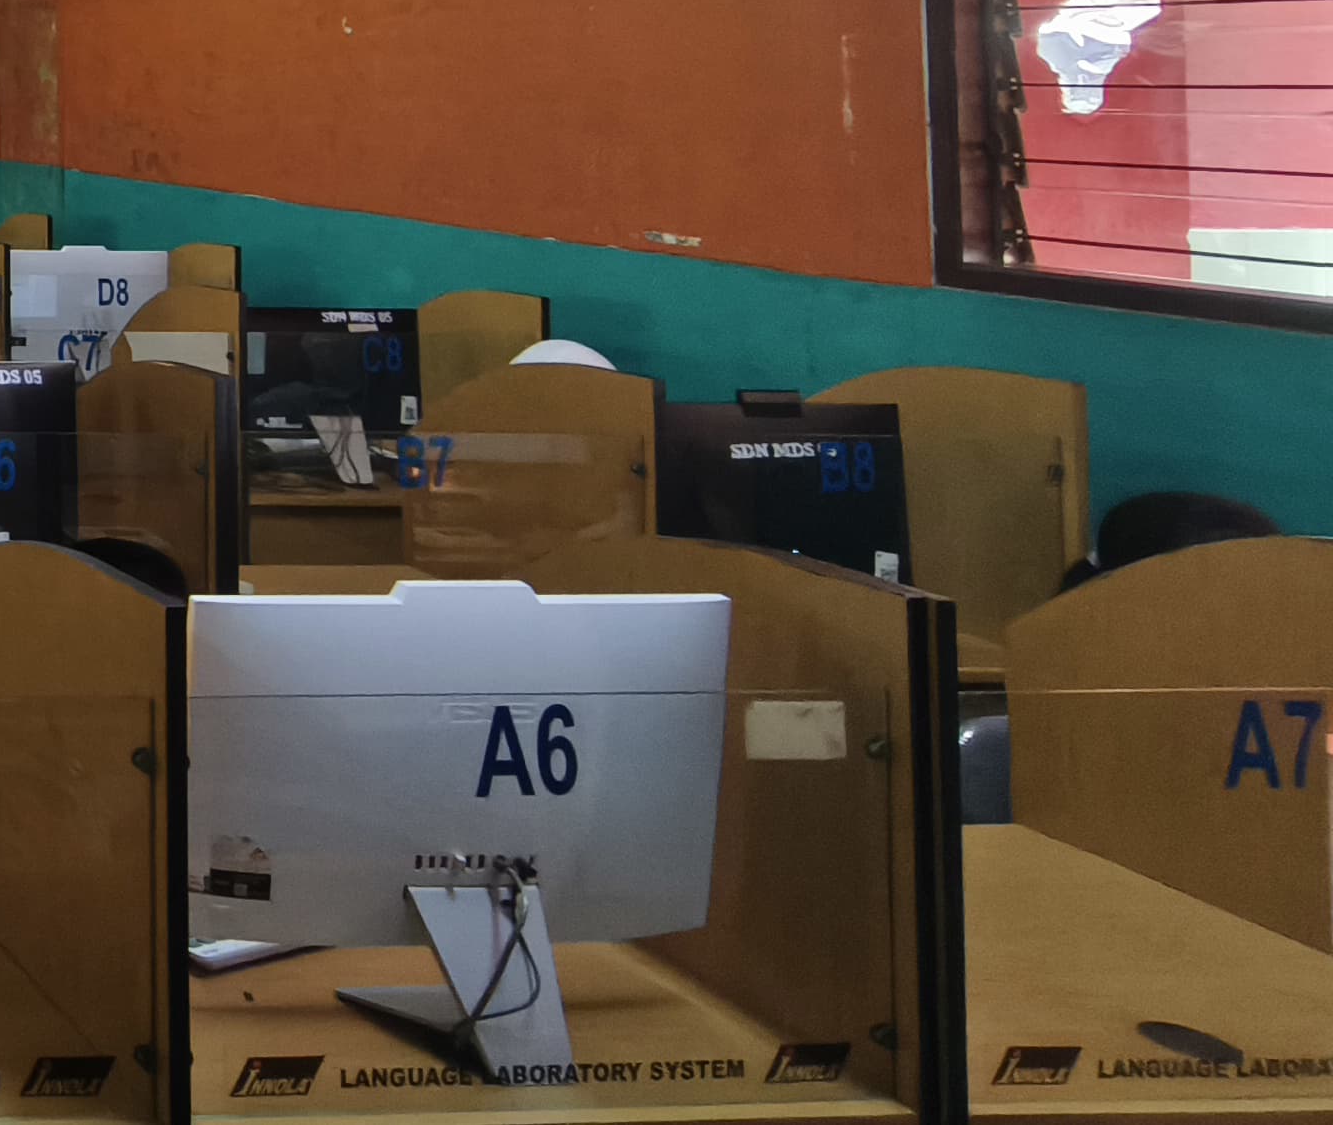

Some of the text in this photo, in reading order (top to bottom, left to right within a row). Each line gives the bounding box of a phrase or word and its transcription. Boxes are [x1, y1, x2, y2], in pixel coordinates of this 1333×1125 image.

[98, 278, 129, 306] D8
[58, 334, 102, 372] C7
[363, 335, 405, 374] C8
[23, 369, 44, 385] 05
[396, 436, 453, 489] B7
[729, 442, 769, 459] SDN
[771, 442, 816, 458] MDS
[819, 442, 876, 493] B8
[475, 704, 579, 797] A6
[1226, 700, 1323, 789] A7
[340, 1066, 473, 1088] LANGUAGE
[650, 1059, 745, 1081] SYSTEM
[1097, 1058, 1230, 1079] LANGUAGE
